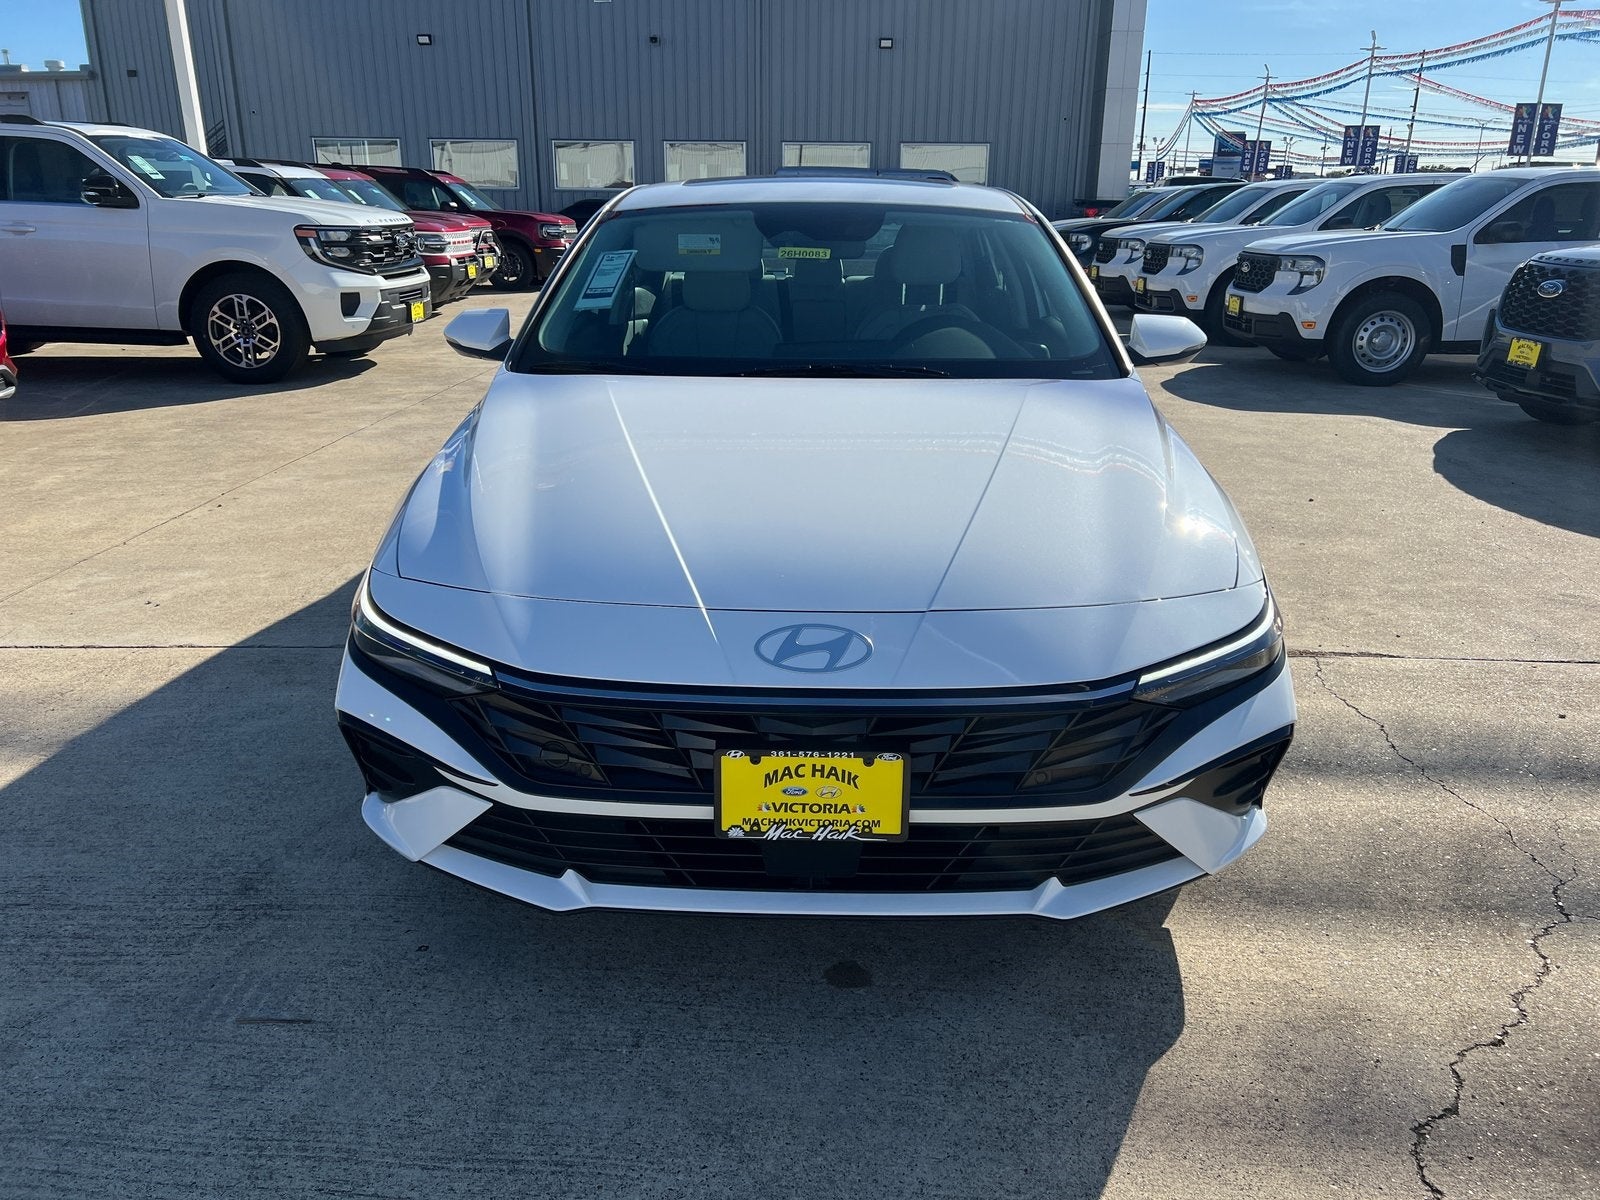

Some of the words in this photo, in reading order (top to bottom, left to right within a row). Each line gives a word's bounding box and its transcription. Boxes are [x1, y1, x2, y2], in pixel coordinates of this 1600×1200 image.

[1513, 124, 1527, 154] NEW
[1540, 124, 1551, 154] FORD
[1344, 141, 1354, 164] NEW
[1364, 141, 1372, 164] FORD
[780, 250, 827, 258] 26H0083
[770, 750, 855, 759] 361-576-1221
[764, 763, 806, 789] MAC
[811, 763, 860, 790] HAIK
[785, 787, 804, 796] Ford
[771, 802, 852, 815] VICTORIA
[742, 818, 881, 828] MACHAIKVICTORIACOM
[763, 823, 805, 841] Mac
